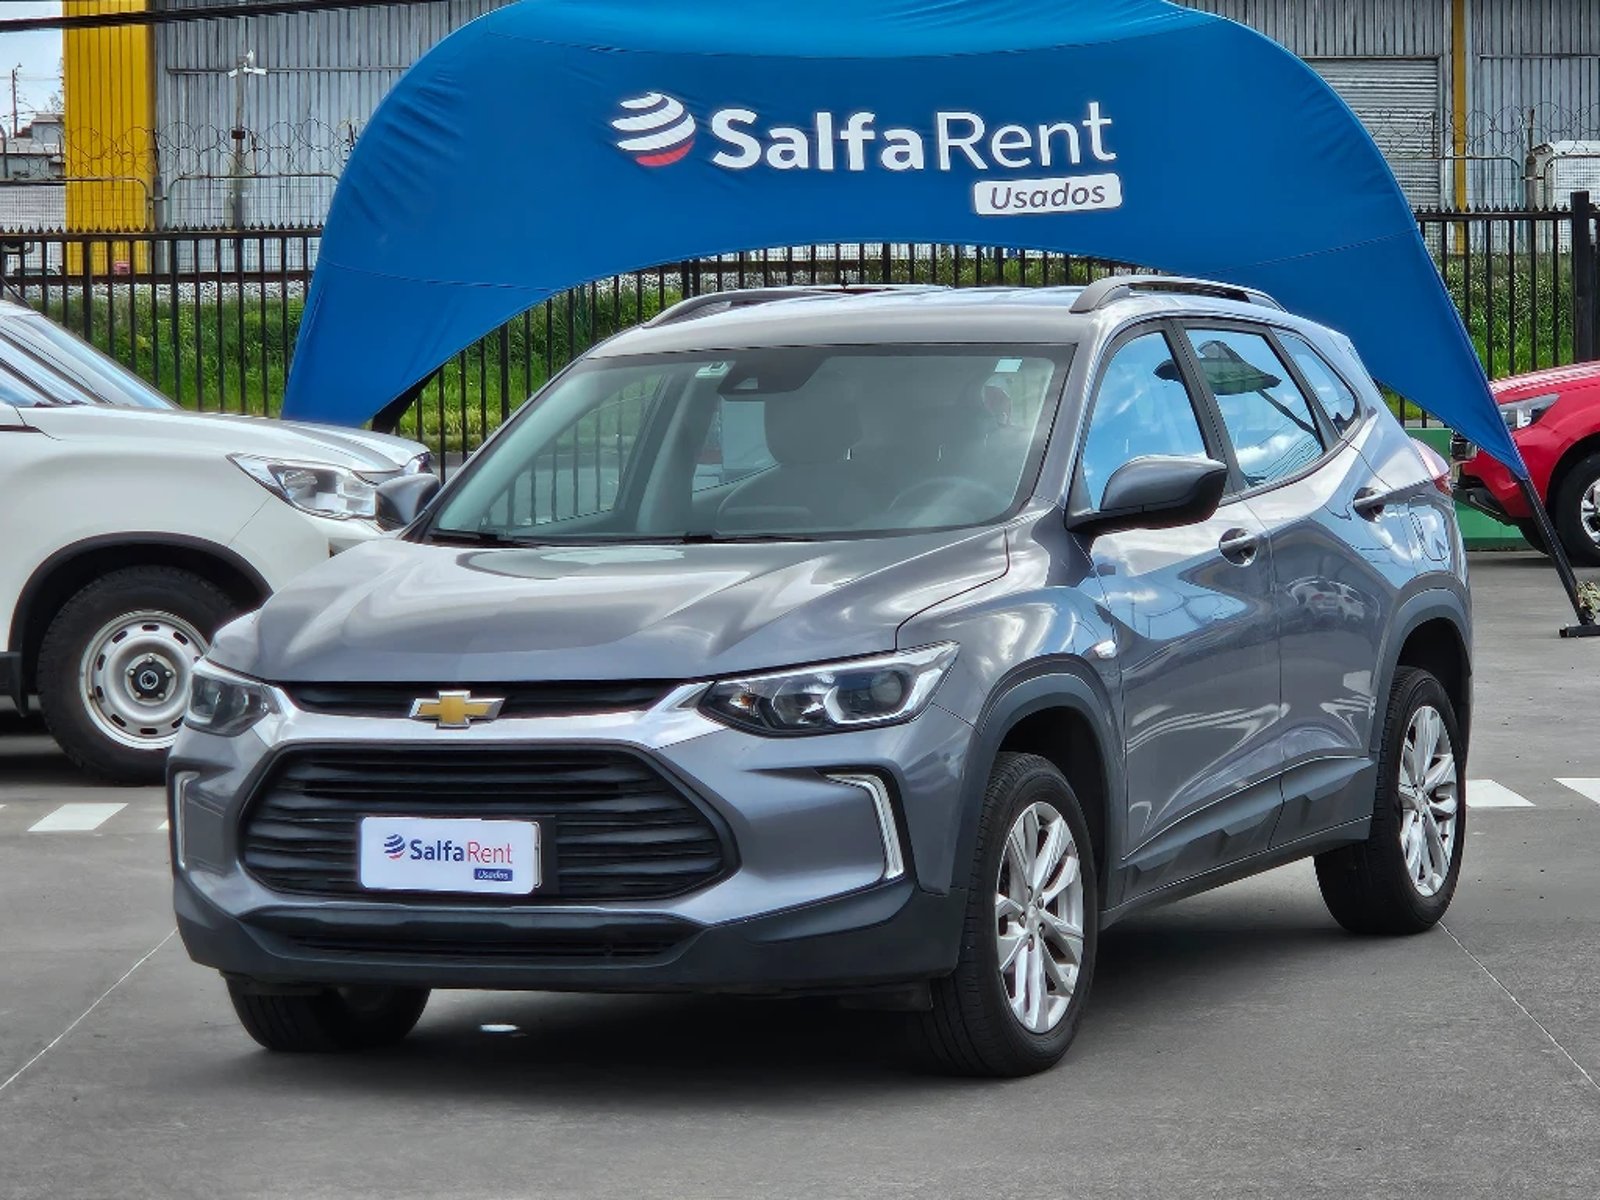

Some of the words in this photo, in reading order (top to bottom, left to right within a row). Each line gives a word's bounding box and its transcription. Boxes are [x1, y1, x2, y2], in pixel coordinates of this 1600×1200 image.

[710, 101, 1117, 171] SalfaRent
[989, 180, 1107, 211] Usados
[409, 838, 514, 864] SalfaRent
